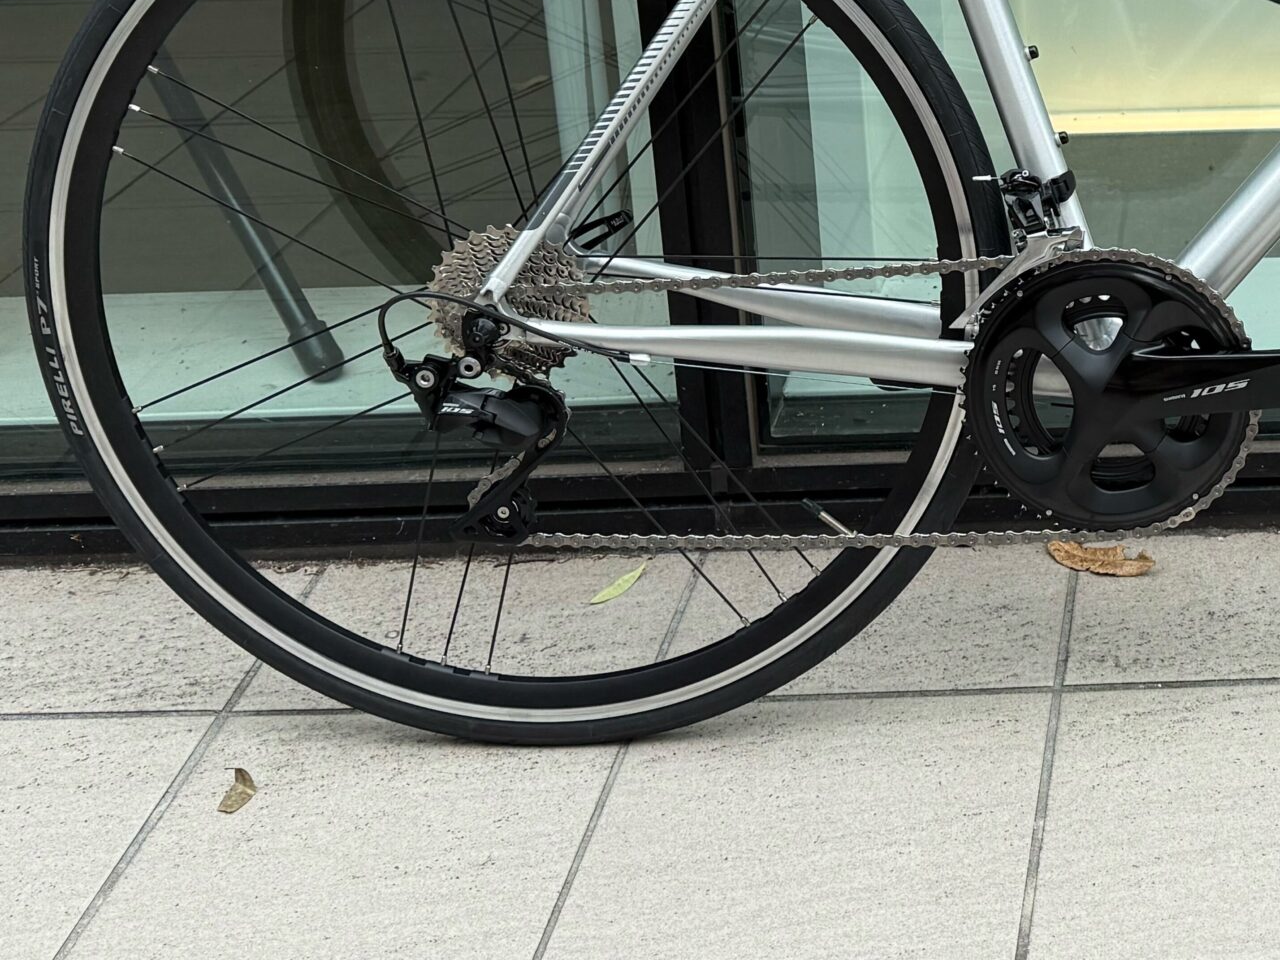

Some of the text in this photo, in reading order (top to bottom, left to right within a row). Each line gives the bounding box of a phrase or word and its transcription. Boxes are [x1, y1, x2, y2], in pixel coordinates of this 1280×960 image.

[45, 346, 85, 436] PIRELLI
[1190, 378, 1251, 399] 105
[440, 406, 475, 415] 105
